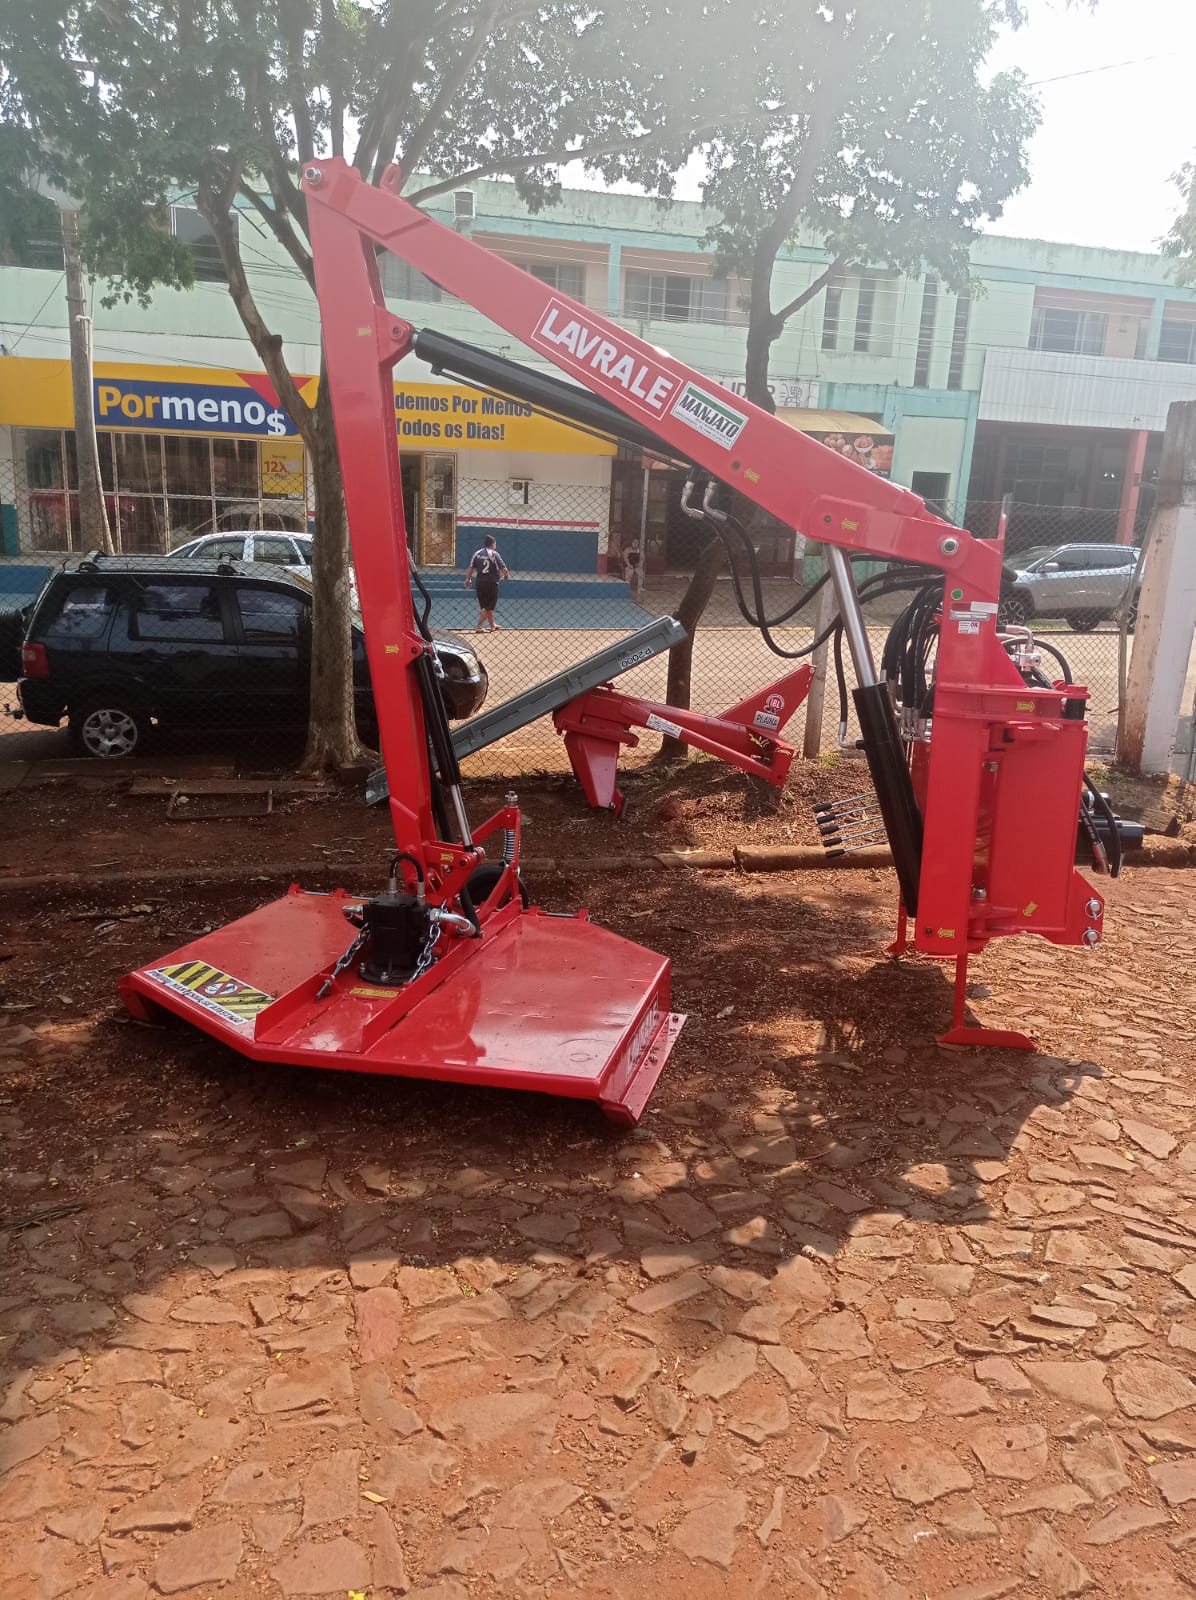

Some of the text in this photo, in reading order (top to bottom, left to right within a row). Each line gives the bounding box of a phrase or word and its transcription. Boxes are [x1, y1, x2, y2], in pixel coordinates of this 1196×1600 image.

[540, 309, 673, 410] LAVRALE
[452, 395, 478, 414] Por
[481, 397, 532, 417] Menos
[679, 394, 740, 438] MANJATO
[396, 418, 505, 440] Todos os Dias!
[482, 559, 490, 573] 2
